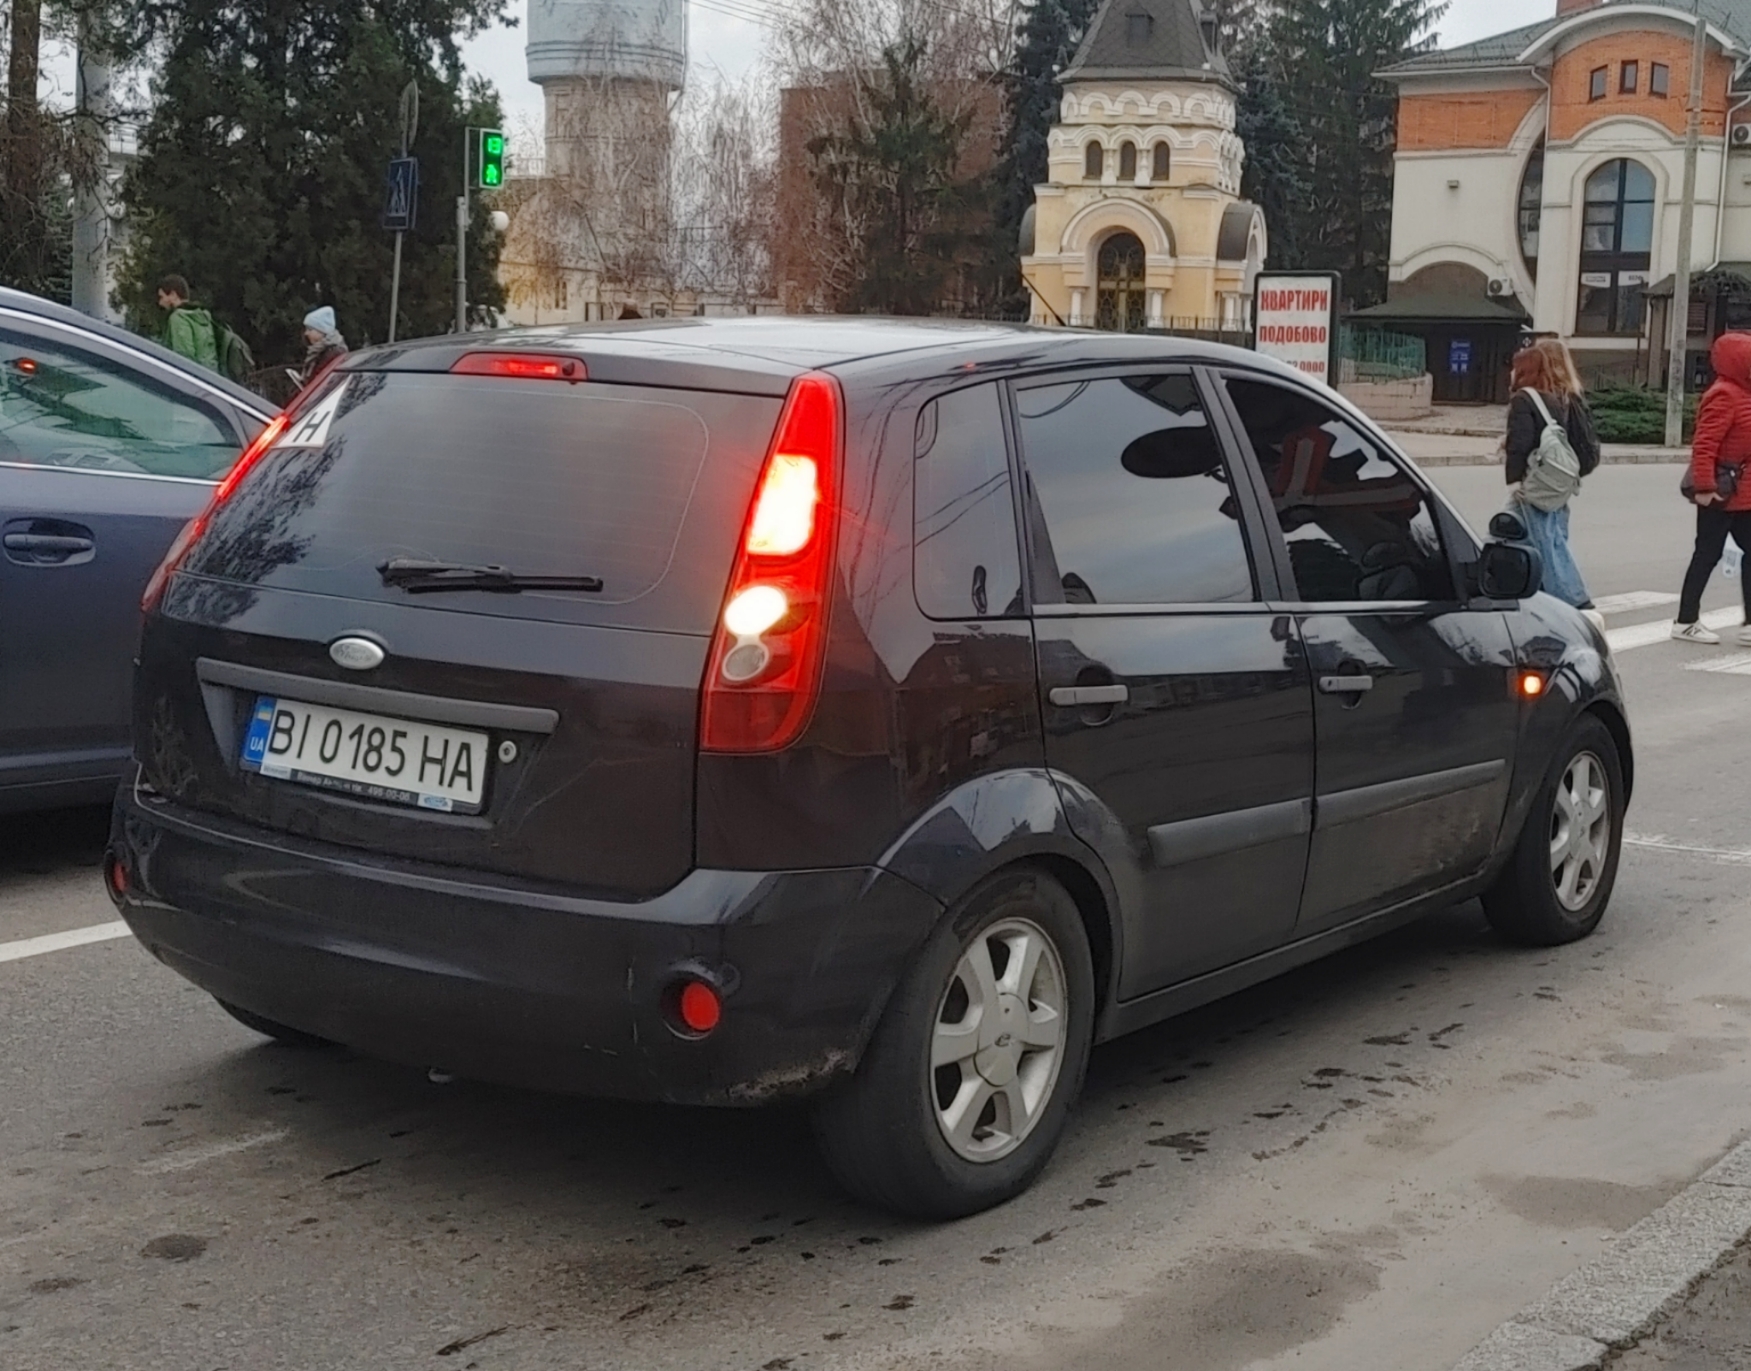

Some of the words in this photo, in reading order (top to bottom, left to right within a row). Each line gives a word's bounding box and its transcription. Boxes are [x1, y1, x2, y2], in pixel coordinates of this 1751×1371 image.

[1260, 290, 1328, 311] КВАРТИРИ
[1259, 325, 1327, 345] ПОДОБОВО
[250, 736, 264, 751] UA
[268, 709, 311, 759] BI
[319, 719, 408, 777] 0185
[418, 735, 473, 792] HA
